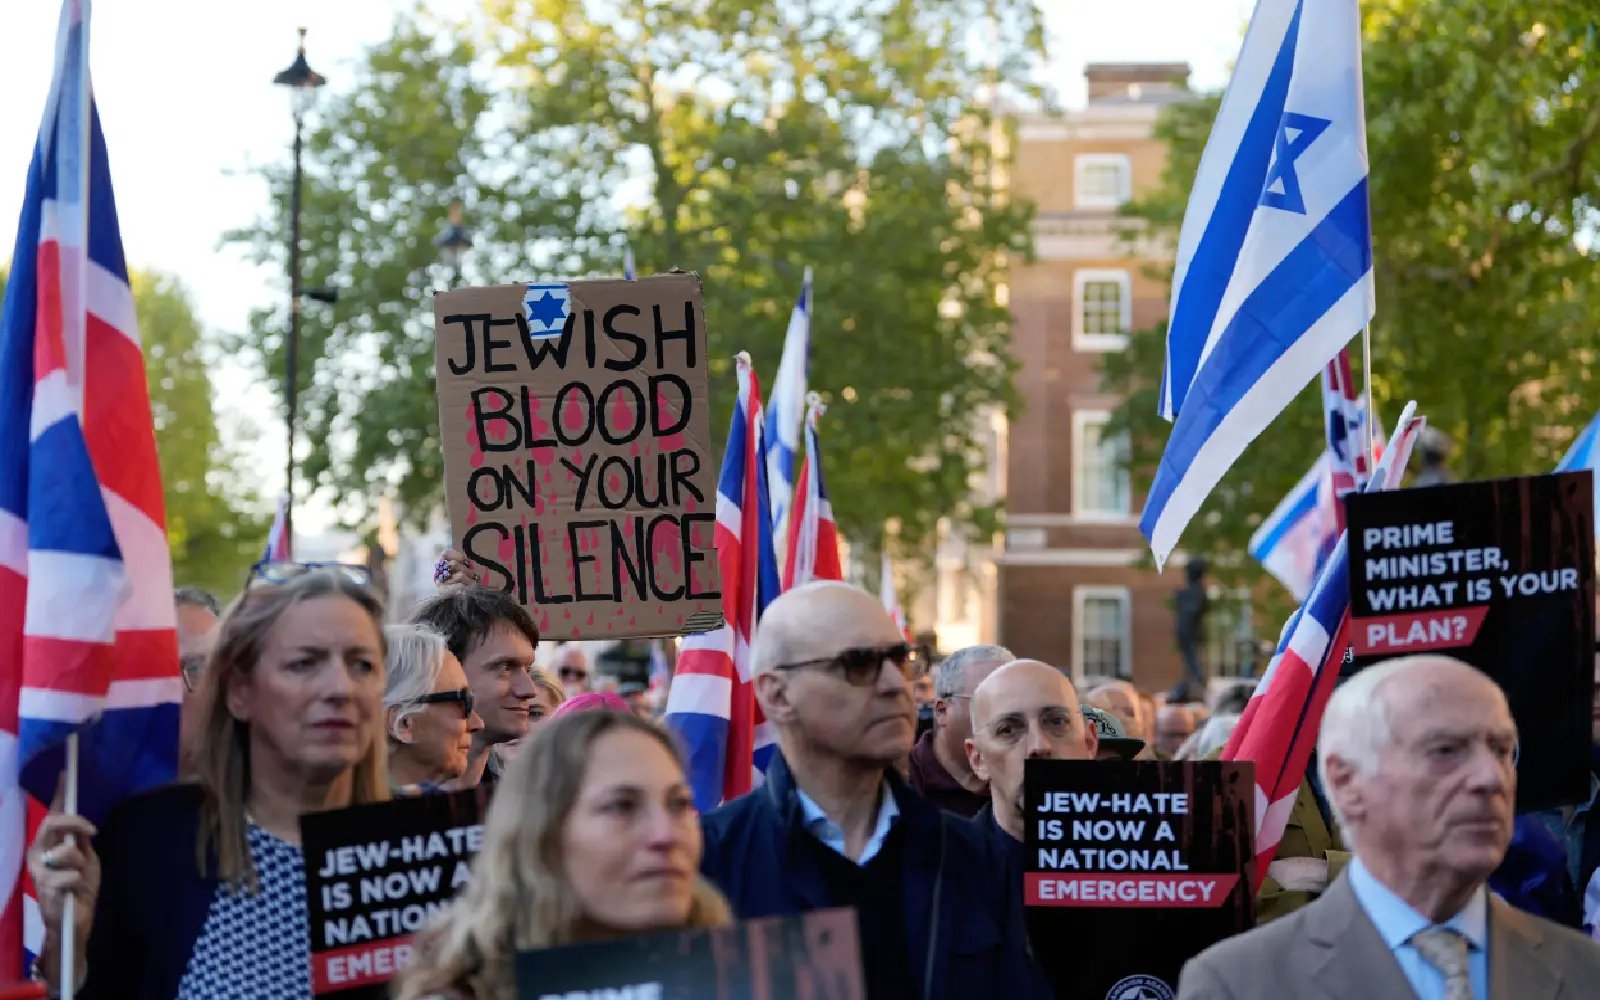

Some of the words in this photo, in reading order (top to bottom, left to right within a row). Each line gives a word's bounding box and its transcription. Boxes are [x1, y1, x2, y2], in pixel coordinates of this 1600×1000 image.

[443, 301, 697, 375] JEWISH
[470, 374, 692, 452] BLOOD
[467, 459, 536, 512] ON
[559, 448, 704, 511] YOUR
[1364, 521, 1454, 550] PRIME
[462, 513, 722, 605] SILENCE
[1366, 547, 1509, 581] MINISTER,
[1367, 582, 1458, 612] WHAT
[1467, 578, 1492, 602] IS
[1500, 568, 1578, 598] YOUR
[1367, 616, 1468, 648] PLAN?
[1037, 792, 1189, 815] JEW-HATE
[319, 824, 484, 878] JEW-HATE
[1038, 819, 1064, 841] IS
[1072, 820, 1146, 842] NOW
[1153, 821, 1175, 842] A
[1038, 848, 1189, 871] NATIONAL
[322, 882, 352, 911] IS
[360, 866, 442, 904] NOW
[451, 860, 472, 888] A
[1038, 879, 1216, 902] EMERGENCY
[324, 898, 452, 947] NATION
[327, 943, 414, 985] EMER
